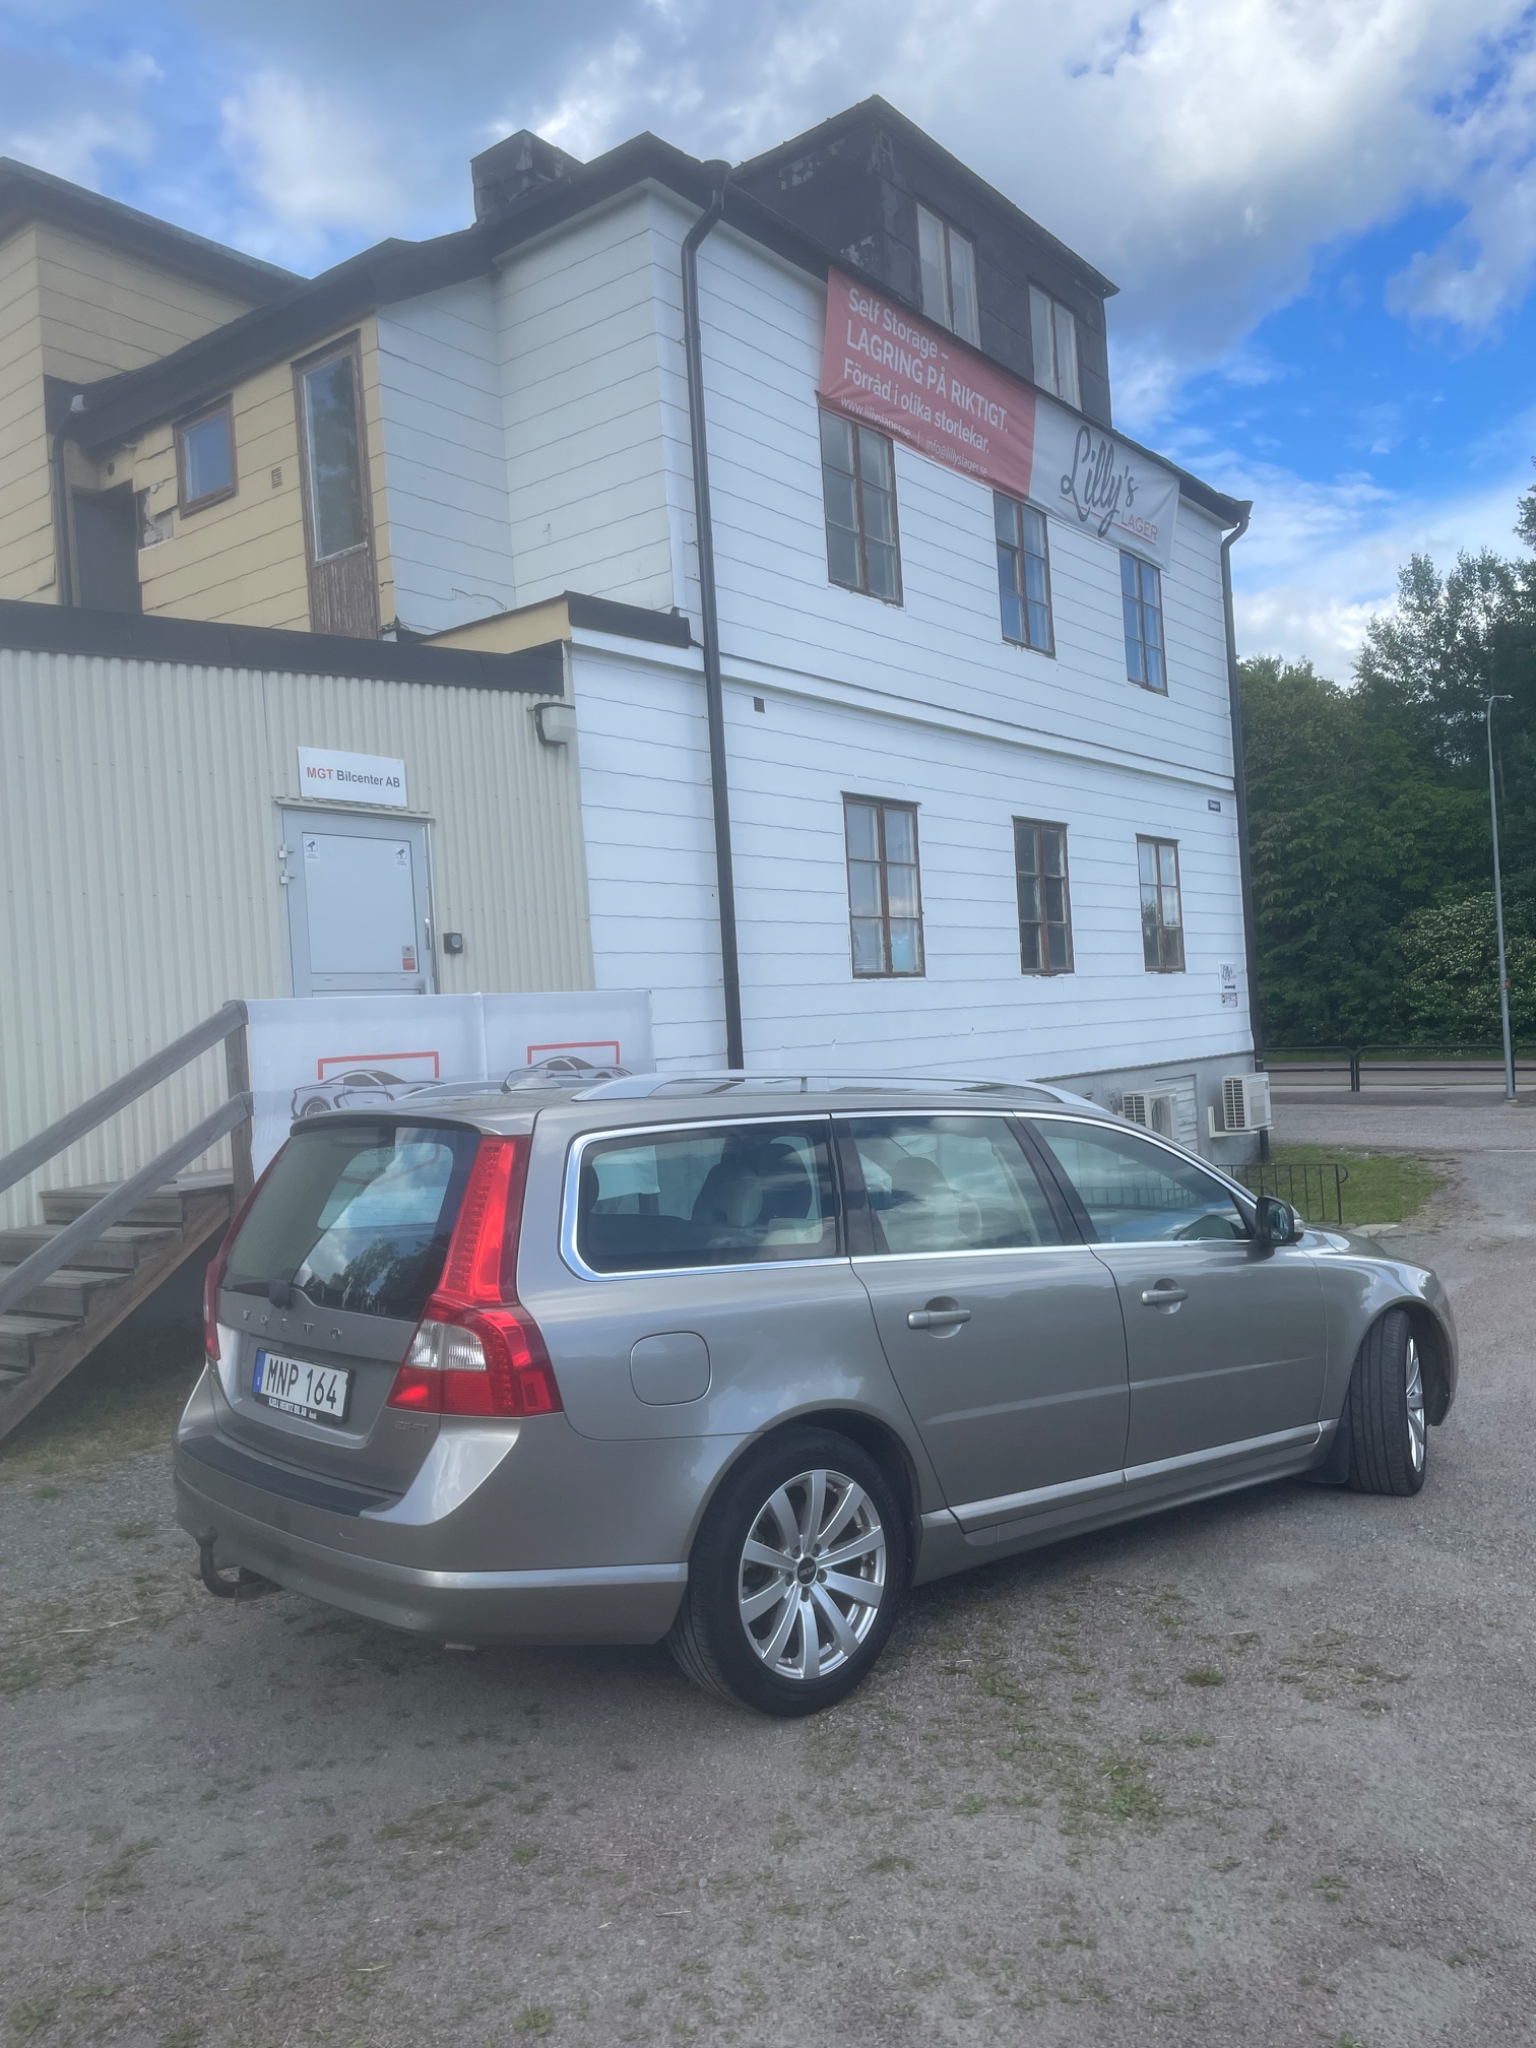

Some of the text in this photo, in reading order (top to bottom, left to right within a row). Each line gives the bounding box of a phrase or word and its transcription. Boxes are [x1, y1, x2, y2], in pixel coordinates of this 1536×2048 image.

[849, 288, 880, 324] Self
[883, 308, 938, 360] Storage
[843, 358, 990, 453] Förråd i olika storlekar.
[847, 320, 1009, 433] LAGRING PÅ RIKTIGT.
[926, 436, 988, 478] info@lillyslager.se
[1060, 425, 1139, 538] Lilly's
[1120, 508, 1158, 539] LAGER
[307, 767, 400, 787] MGT Bilcenter AB
[266, 1358, 337, 1410] MNP 164
